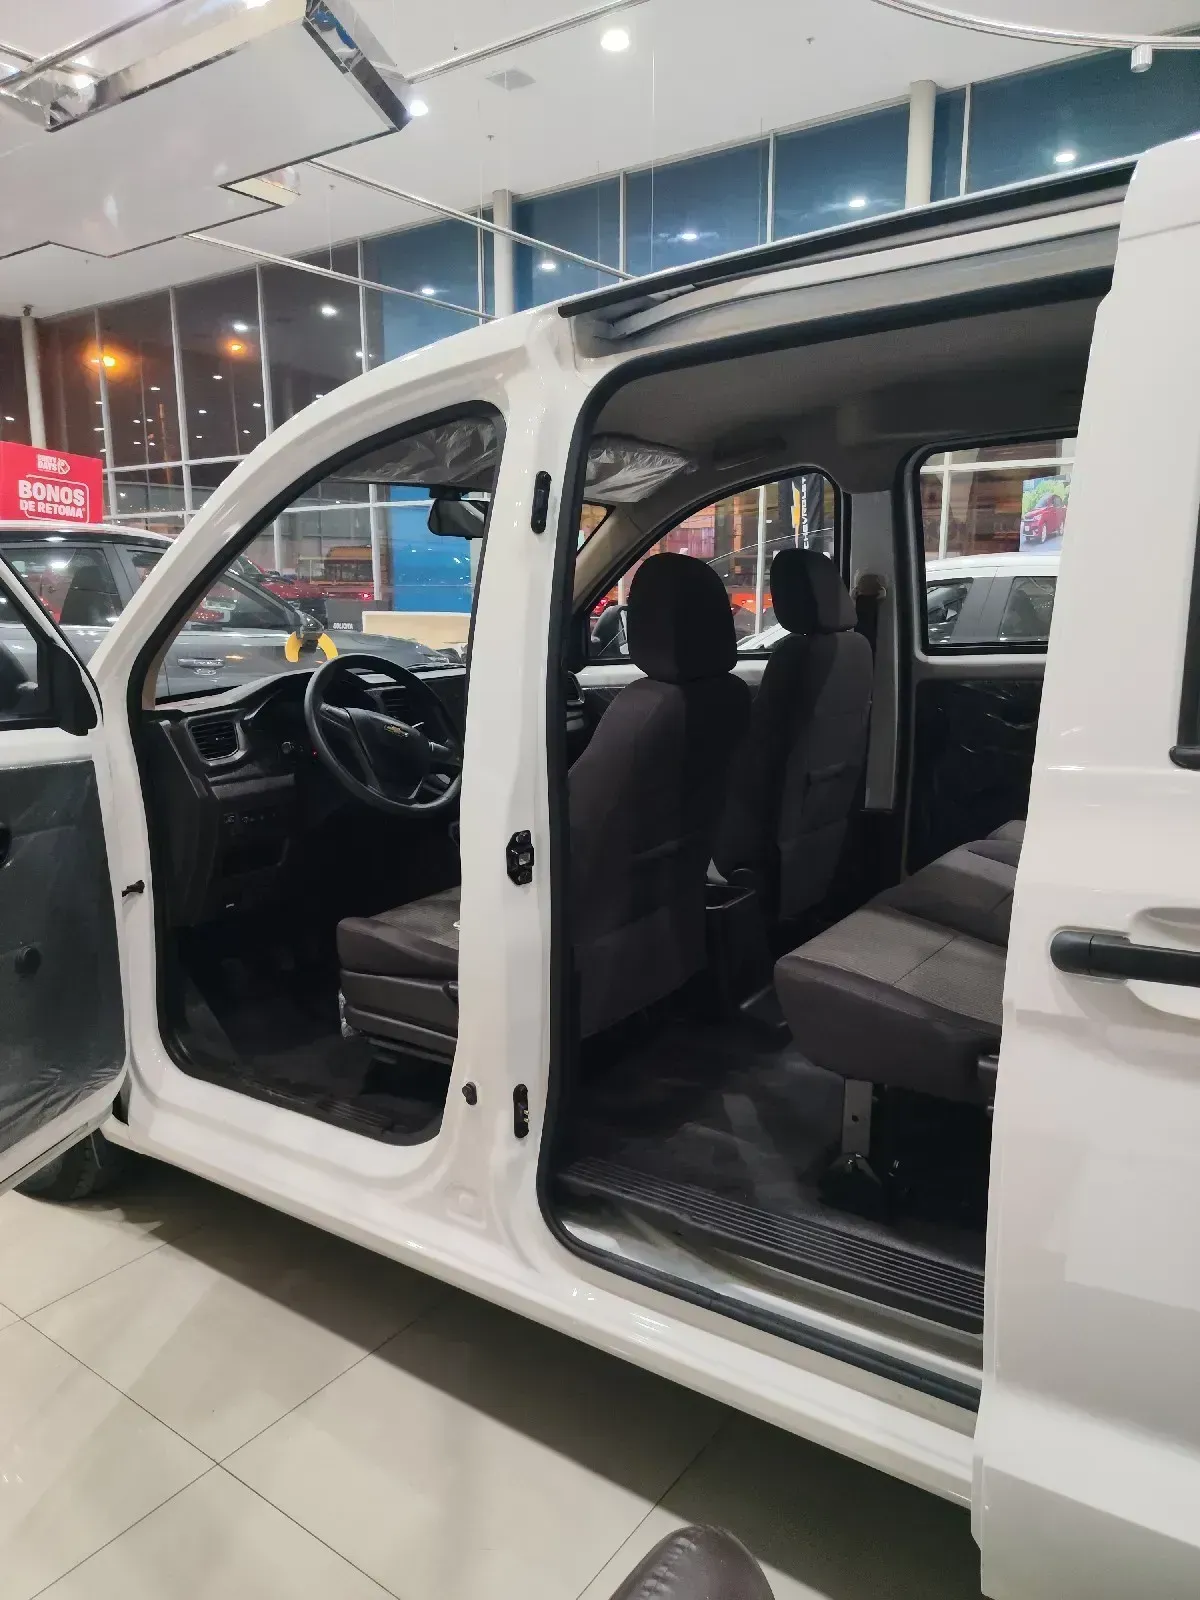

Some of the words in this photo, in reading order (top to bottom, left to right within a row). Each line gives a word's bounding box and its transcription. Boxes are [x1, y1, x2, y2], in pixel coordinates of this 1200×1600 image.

[18, 479, 85, 507] BONOS
[19, 499, 36, 512] DE
[801, 476, 810, 549] CHEVROLET
